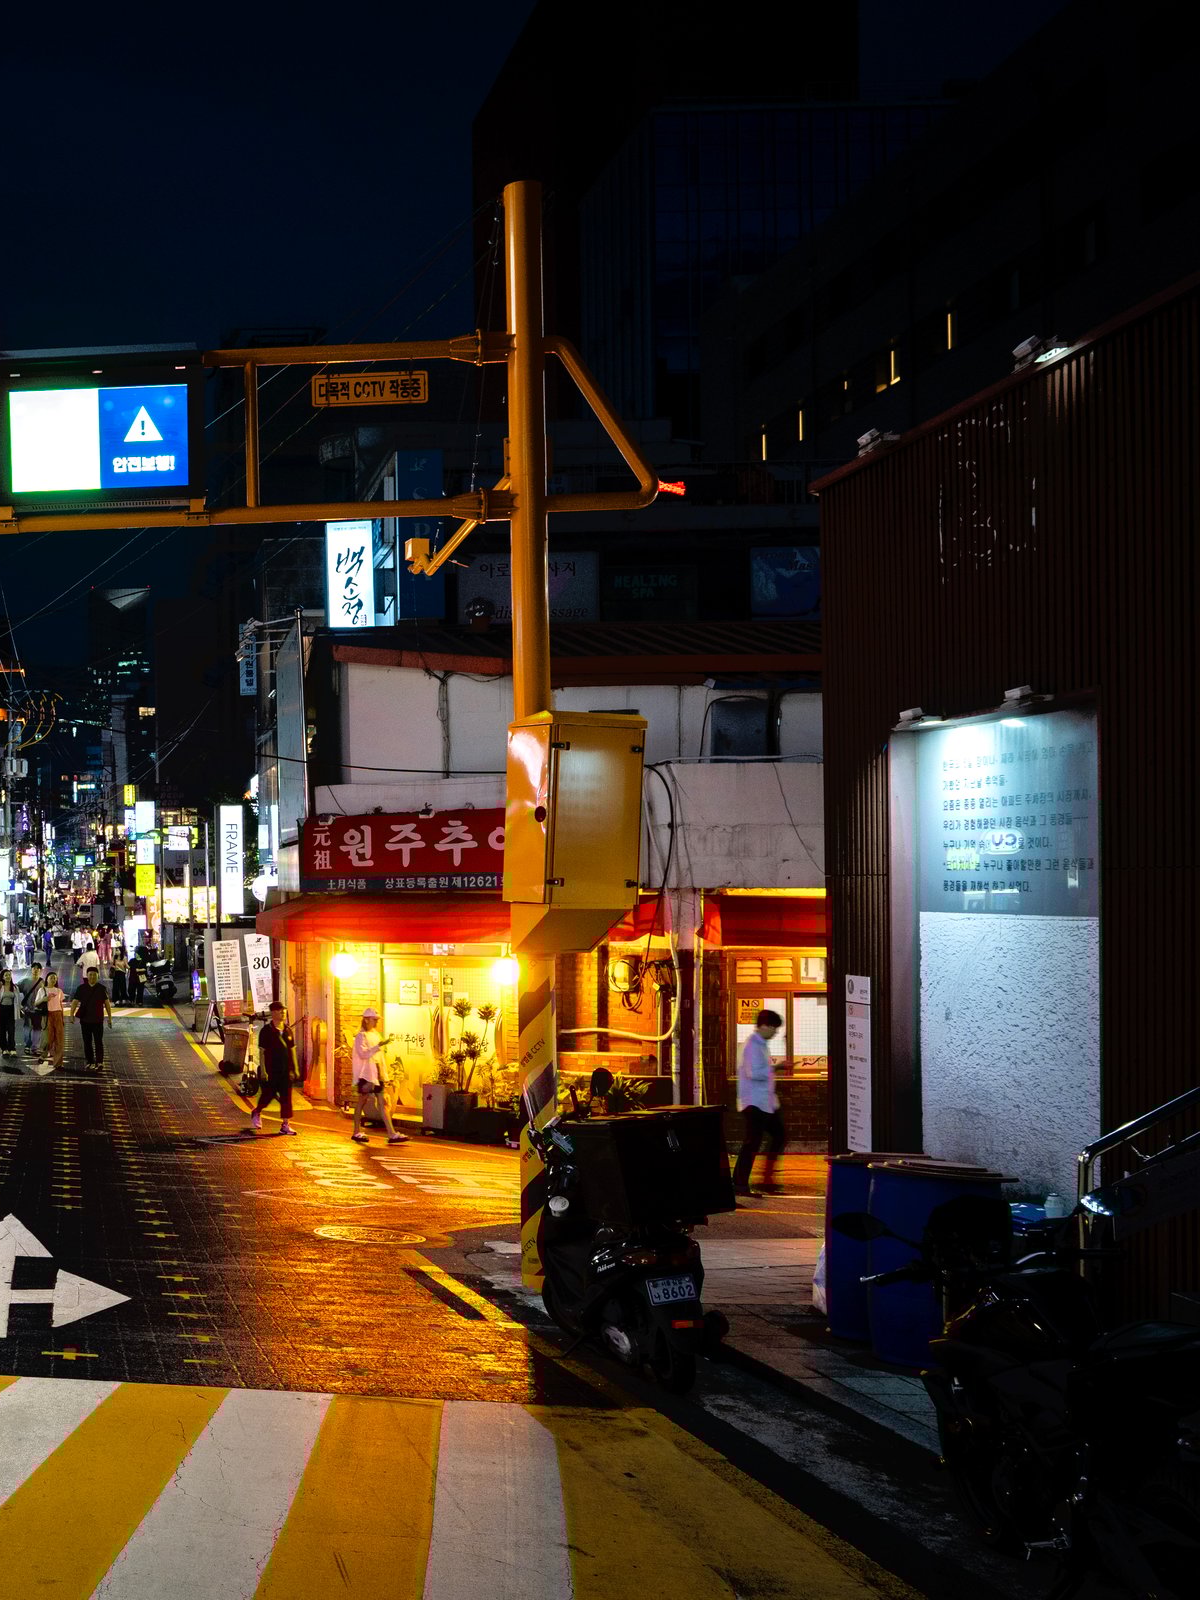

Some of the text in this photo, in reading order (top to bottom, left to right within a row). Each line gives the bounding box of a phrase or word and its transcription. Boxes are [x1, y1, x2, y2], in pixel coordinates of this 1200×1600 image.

[319, 378, 421, 400] 다목적 CCTV 작동중
[614, 574, 678, 588] HEALING
[1001, 794, 1022, 807] 아파트
[943, 820, 961, 831] 우리가
[964, 818, 996, 830] 경험해왔던
[999, 816, 1012, 829] 시장
[1016, 815, 1036, 828] 음식과
[1040, 815, 1047, 826] 그
[225, 822, 238, 874] FRAME
[313, 825, 333, 870] 元祖
[943, 838, 961, 850] 누구나
[1027, 837, 1052, 849] 것이다.
[984, 860, 1003, 871] 누구나
[1045, 858, 1060, 871] 그런
[385, 877, 449, 890] 상표등록출원
[943, 880, 967, 892] 풍경들을
[970, 880, 990, 892] 재해석
[253, 956, 270, 970] 30
[530, 1038, 547, 1056] CCTV
[663, 1285, 694, 1300] 8602
